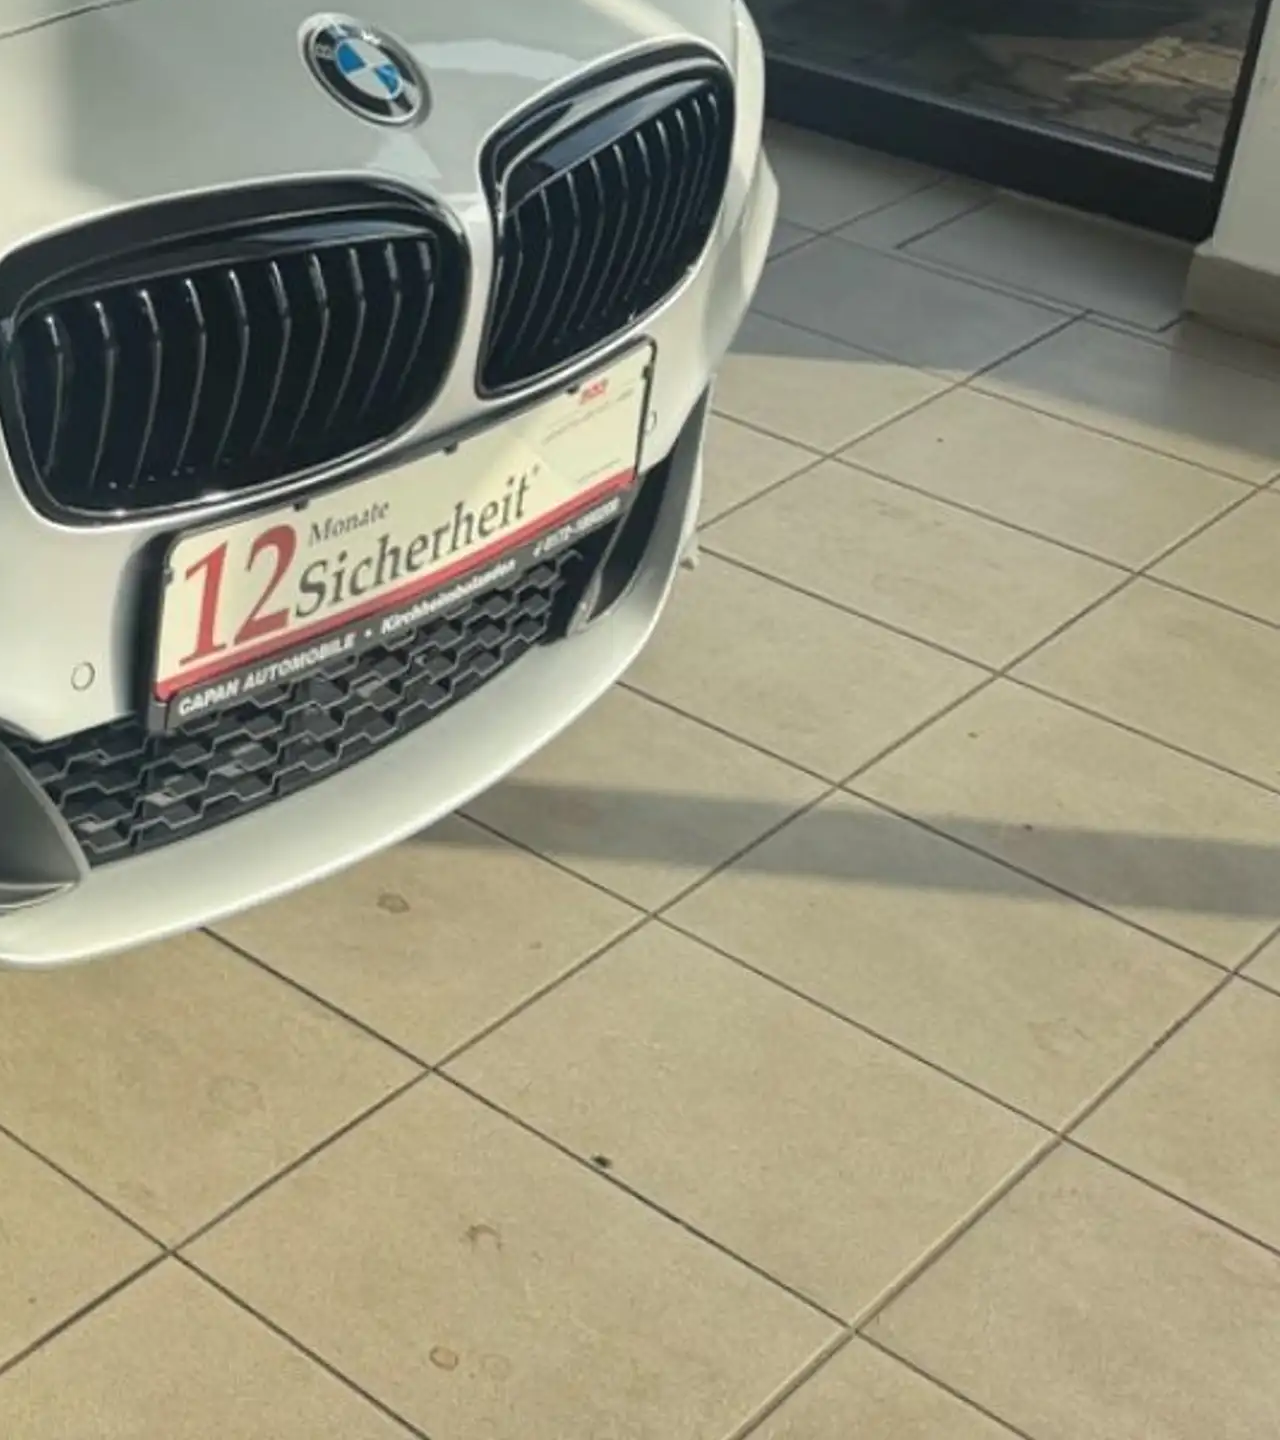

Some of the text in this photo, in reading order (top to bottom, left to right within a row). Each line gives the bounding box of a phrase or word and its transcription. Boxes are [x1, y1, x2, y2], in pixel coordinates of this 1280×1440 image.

[178, 500, 391, 668] 12 Monate
[177, 679, 239, 717] CAPAN
[242, 630, 358, 691] AUTOMOBILE
